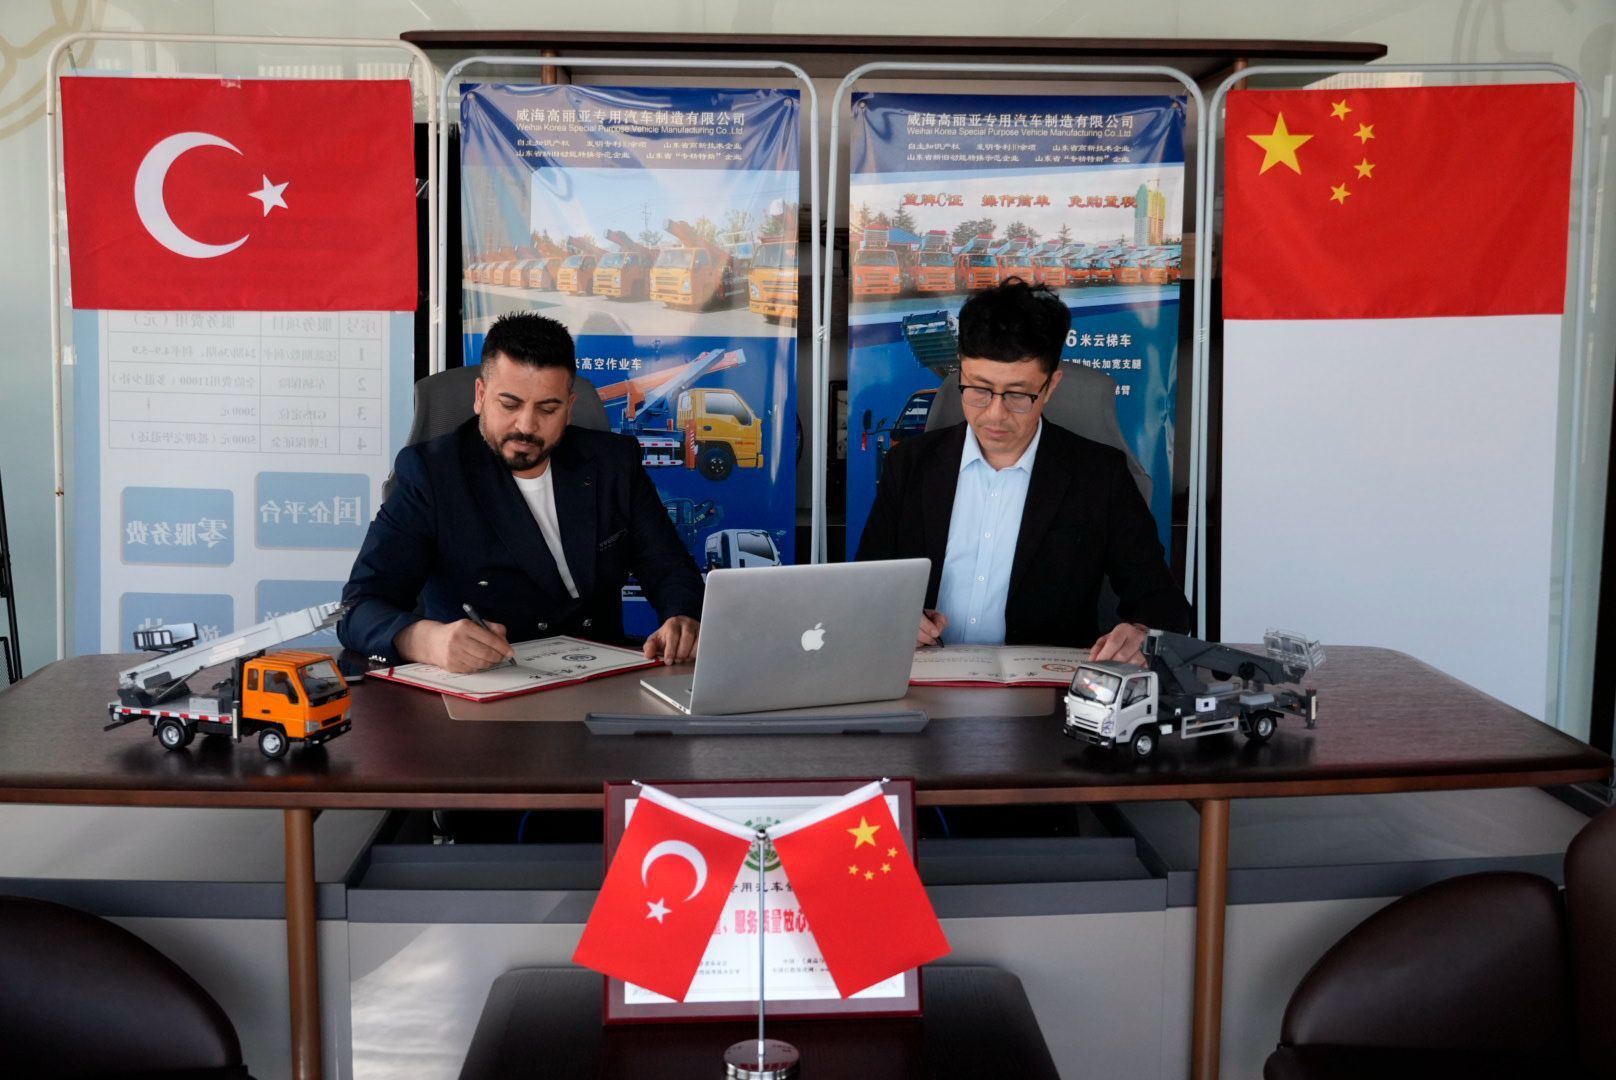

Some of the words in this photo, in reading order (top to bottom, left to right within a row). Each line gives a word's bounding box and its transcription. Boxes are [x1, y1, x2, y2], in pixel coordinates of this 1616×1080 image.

[516, 109, 745, 126] 威海高丽亚专用汽车制造有限公司
[907, 112, 1134, 129] 威海高丽亚专用汽车制造有限公司
[516, 123, 542, 132] Weihai
[544, 124, 567, 132] Korea
[569, 124, 595, 134] Special
[598, 125, 630, 135] Purpose
[631, 126, 659, 134] Vehicle
[661, 126, 714, 136] Manufacturing
[907, 127, 932, 135] Weihai
[934, 127, 957, 135] Korea
[959, 127, 986, 136] Special
[988, 128, 1019, 137] Purpose
[1021, 128, 1048, 137] Vehicle
[1050, 128, 1103, 138] Manufacturing
[981, 194, 1051, 208] 操作简单
